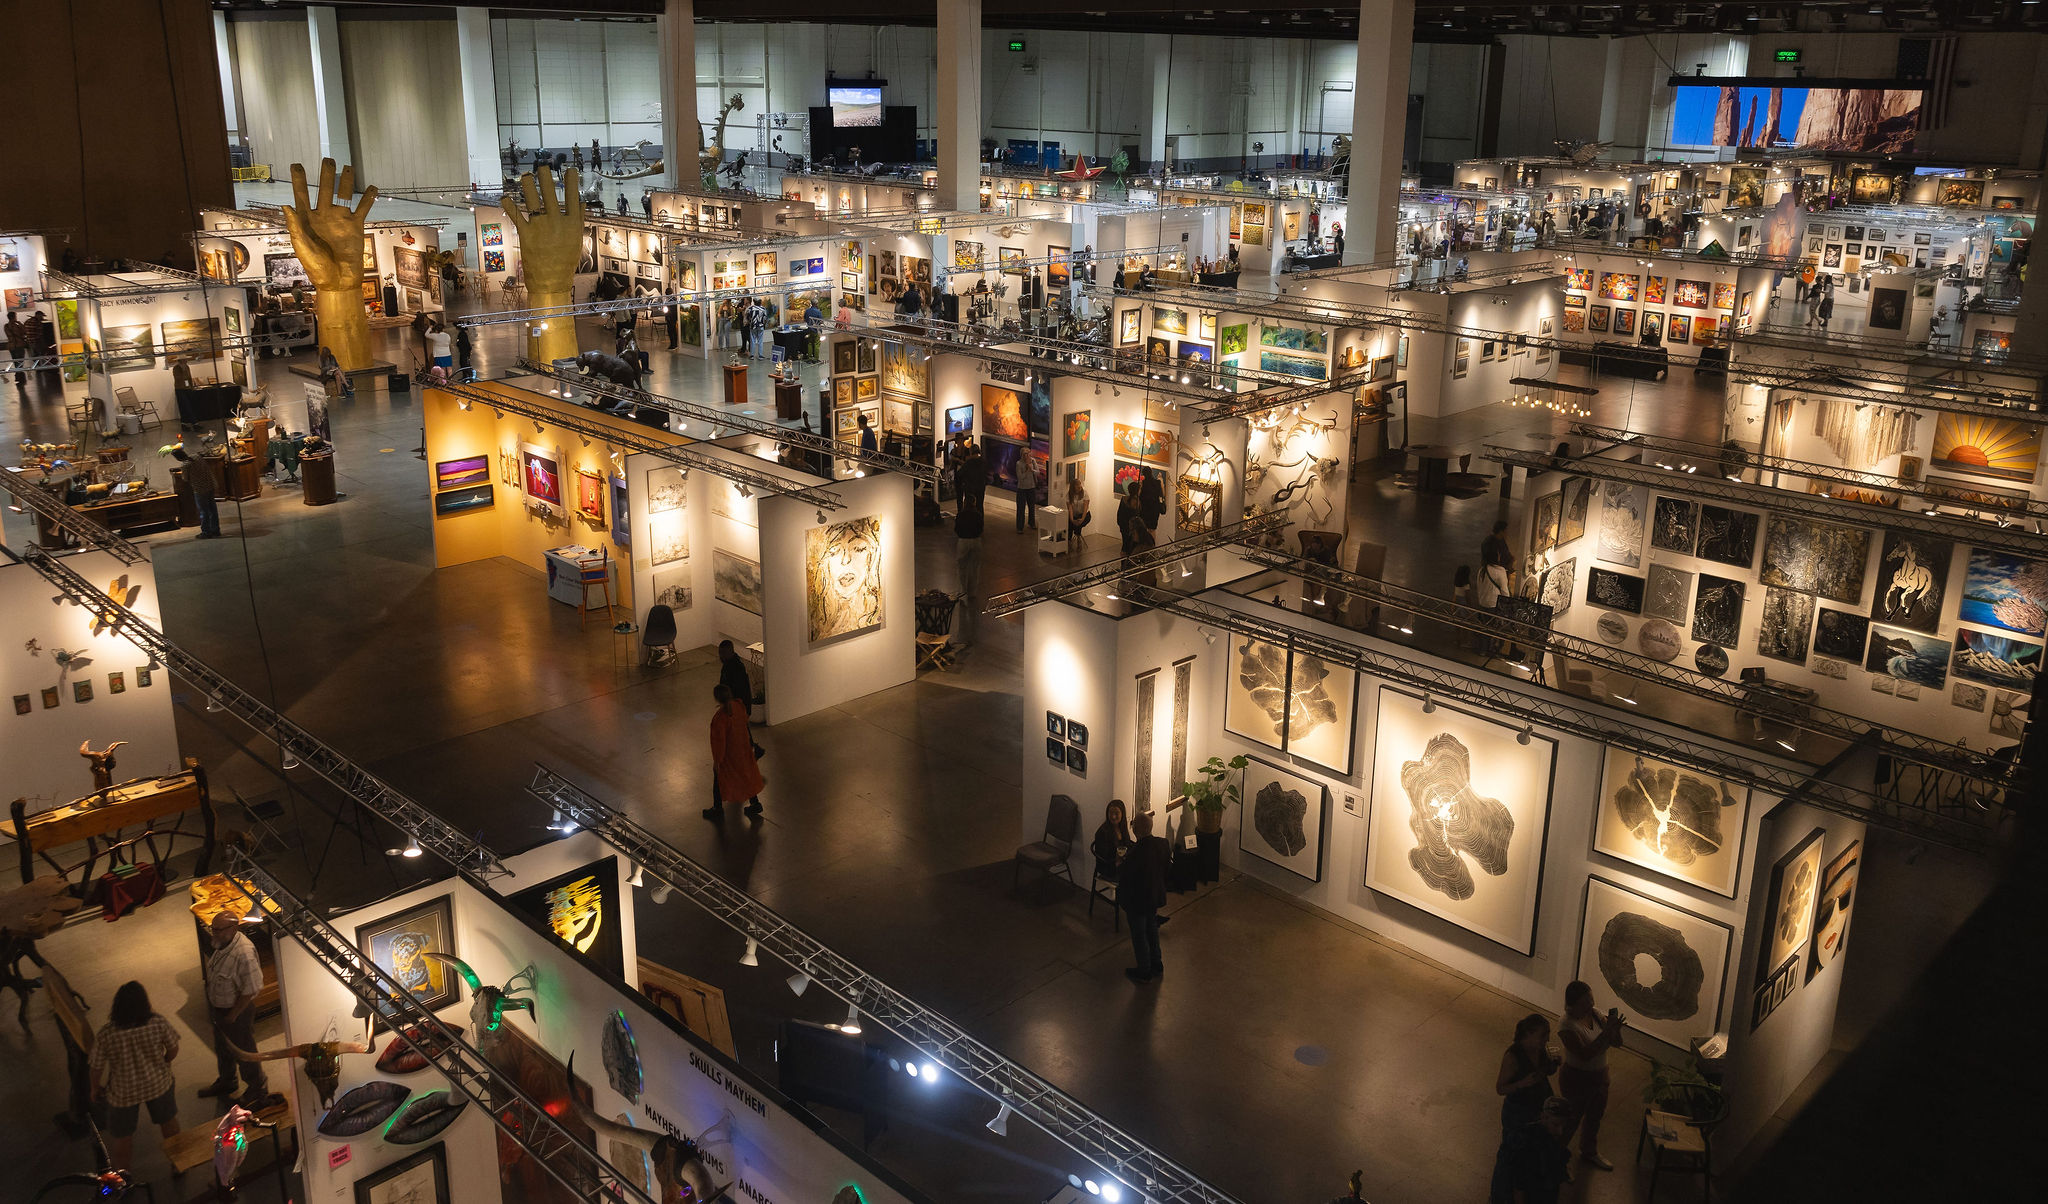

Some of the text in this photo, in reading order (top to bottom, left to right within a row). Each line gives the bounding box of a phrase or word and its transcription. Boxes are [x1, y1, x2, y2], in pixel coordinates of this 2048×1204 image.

[100, 300, 114, 308] RACY
[689, 1052, 766, 1118] SKULLS MAYHEM
[645, 1103, 681, 1143] MAYHEM
[739, 1178, 773, 1204] ANAR
